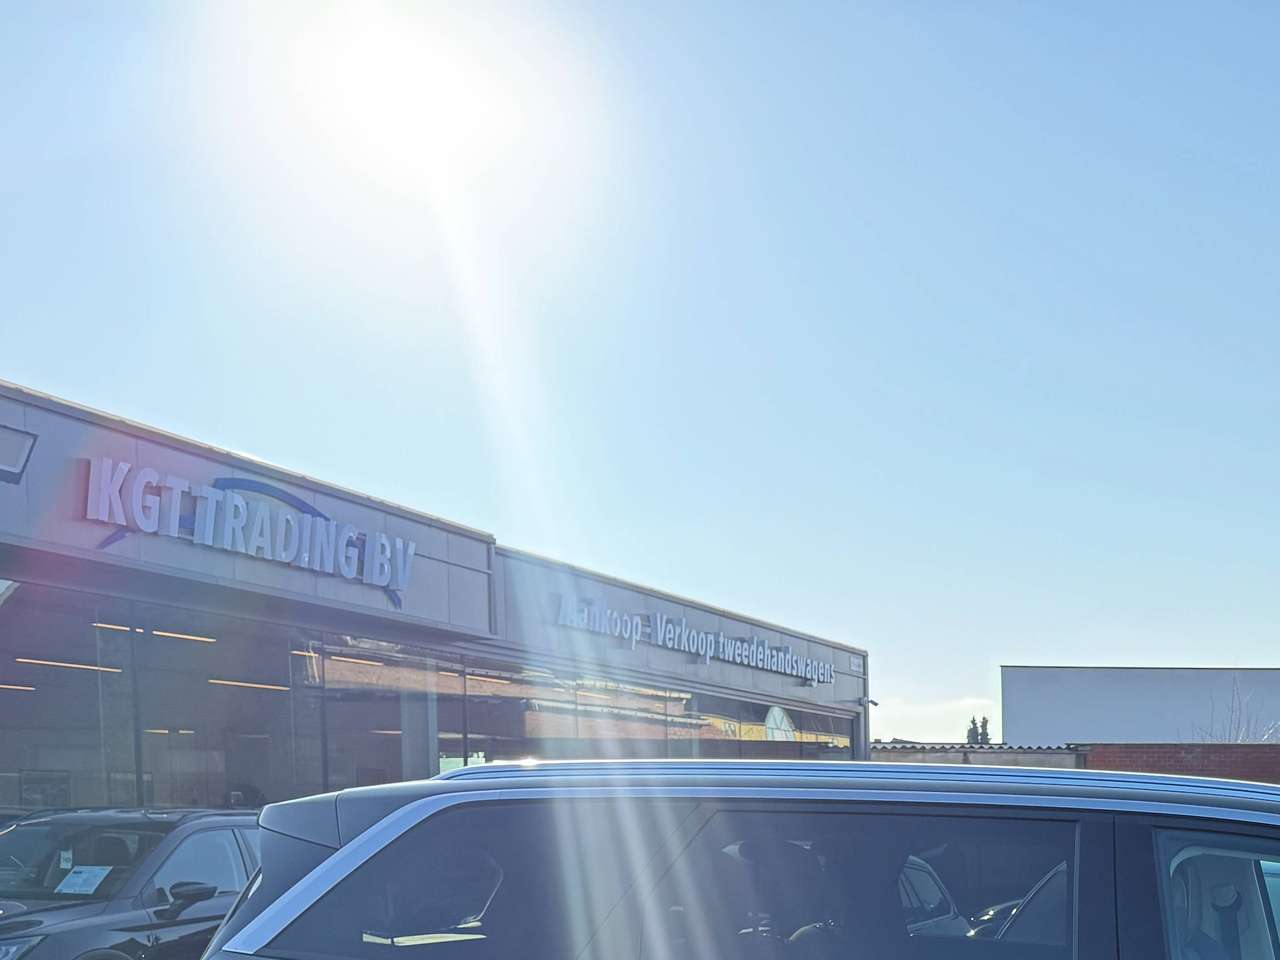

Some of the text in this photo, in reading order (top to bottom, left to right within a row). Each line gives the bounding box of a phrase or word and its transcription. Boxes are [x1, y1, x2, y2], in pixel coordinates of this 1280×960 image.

[86, 457, 416, 593] KGT TRADING BV
[656, 612, 715, 664] Verkoop
[719, 631, 836, 688] tweedehandswagens
